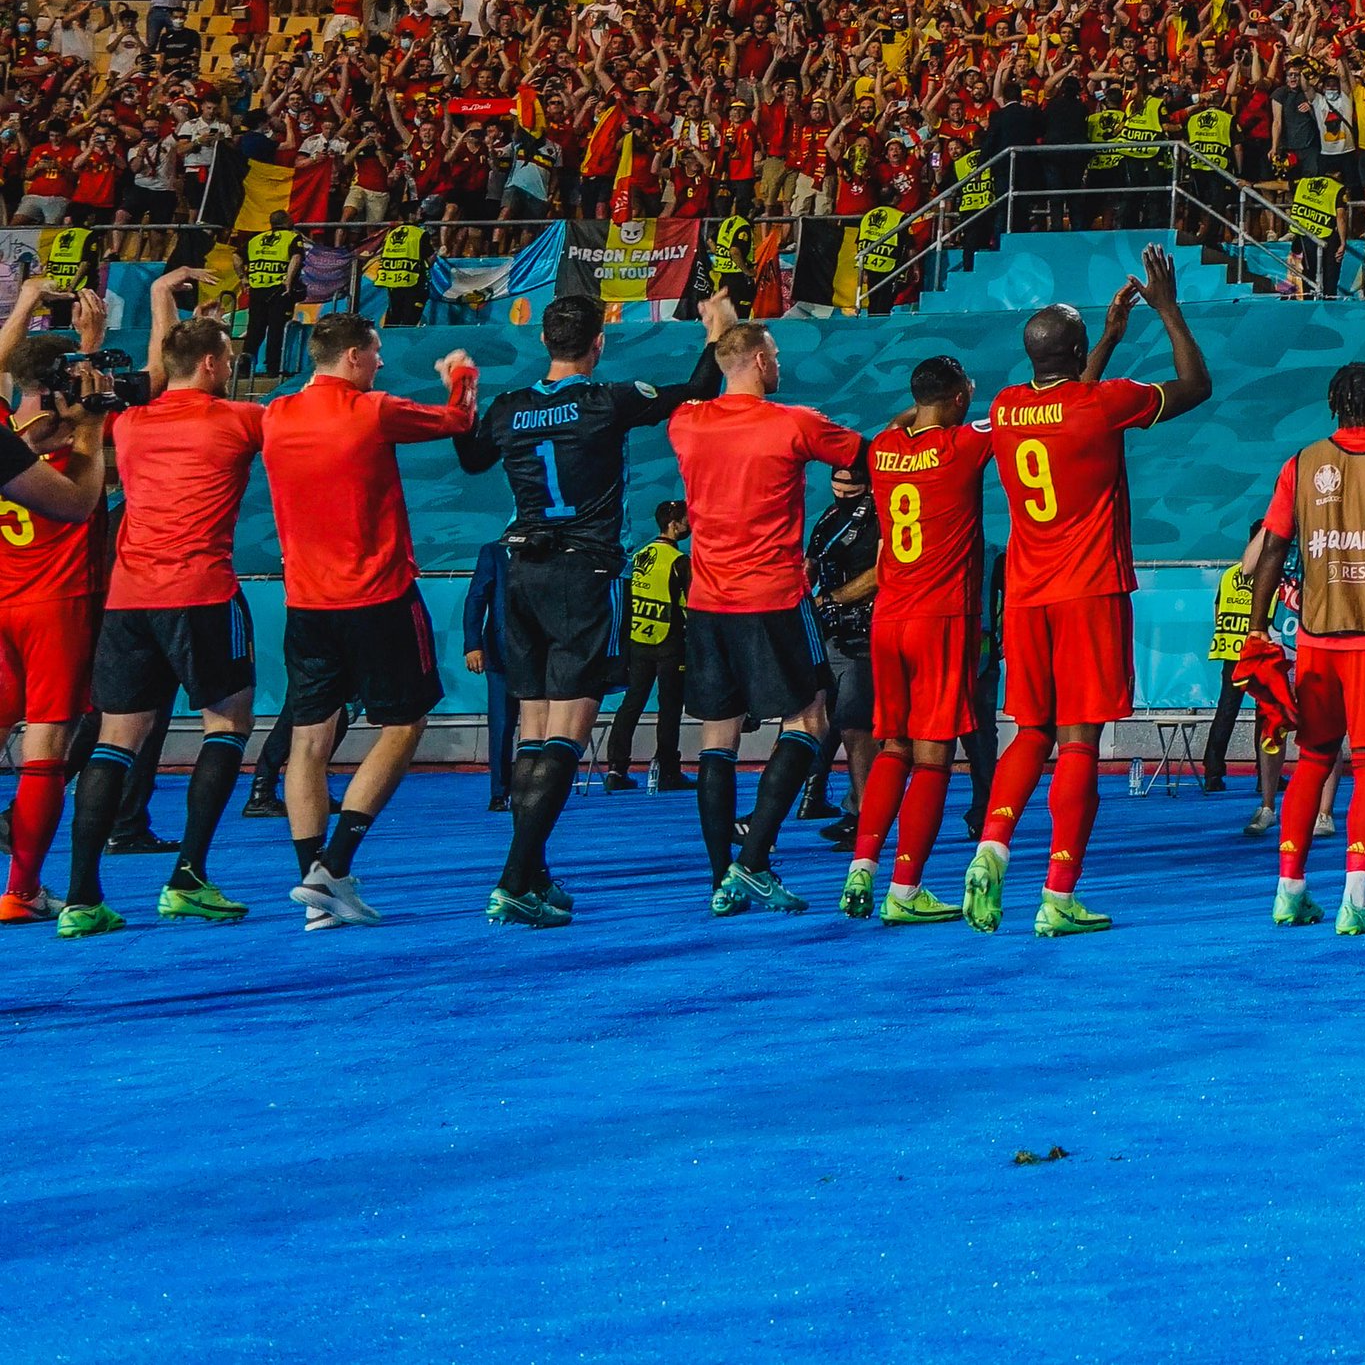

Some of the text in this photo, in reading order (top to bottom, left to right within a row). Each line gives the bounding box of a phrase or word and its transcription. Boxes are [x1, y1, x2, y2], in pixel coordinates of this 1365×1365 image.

[1121, 128, 1157, 141] CURITY
[1292, 204, 1331, 225] ECURITY
[632, 244, 689, 263] FAMILY
[594, 266, 656, 280] ON TOUR
[513, 402, 579, 430] COURTOIS
[997, 402, 1063, 426] R. LUKAKU
[875, 448, 940, 472] TIELEMANS
[535, 440, 577, 518] 1
[1016, 439, 1058, 522] 9
[889, 483, 923, 563] 8
[632, 598, 666, 618] RITY
[632, 621, 655, 638] 74
[1216, 615, 1249, 633] ECUR
[1209, 637, 1243, 653] 03-0
